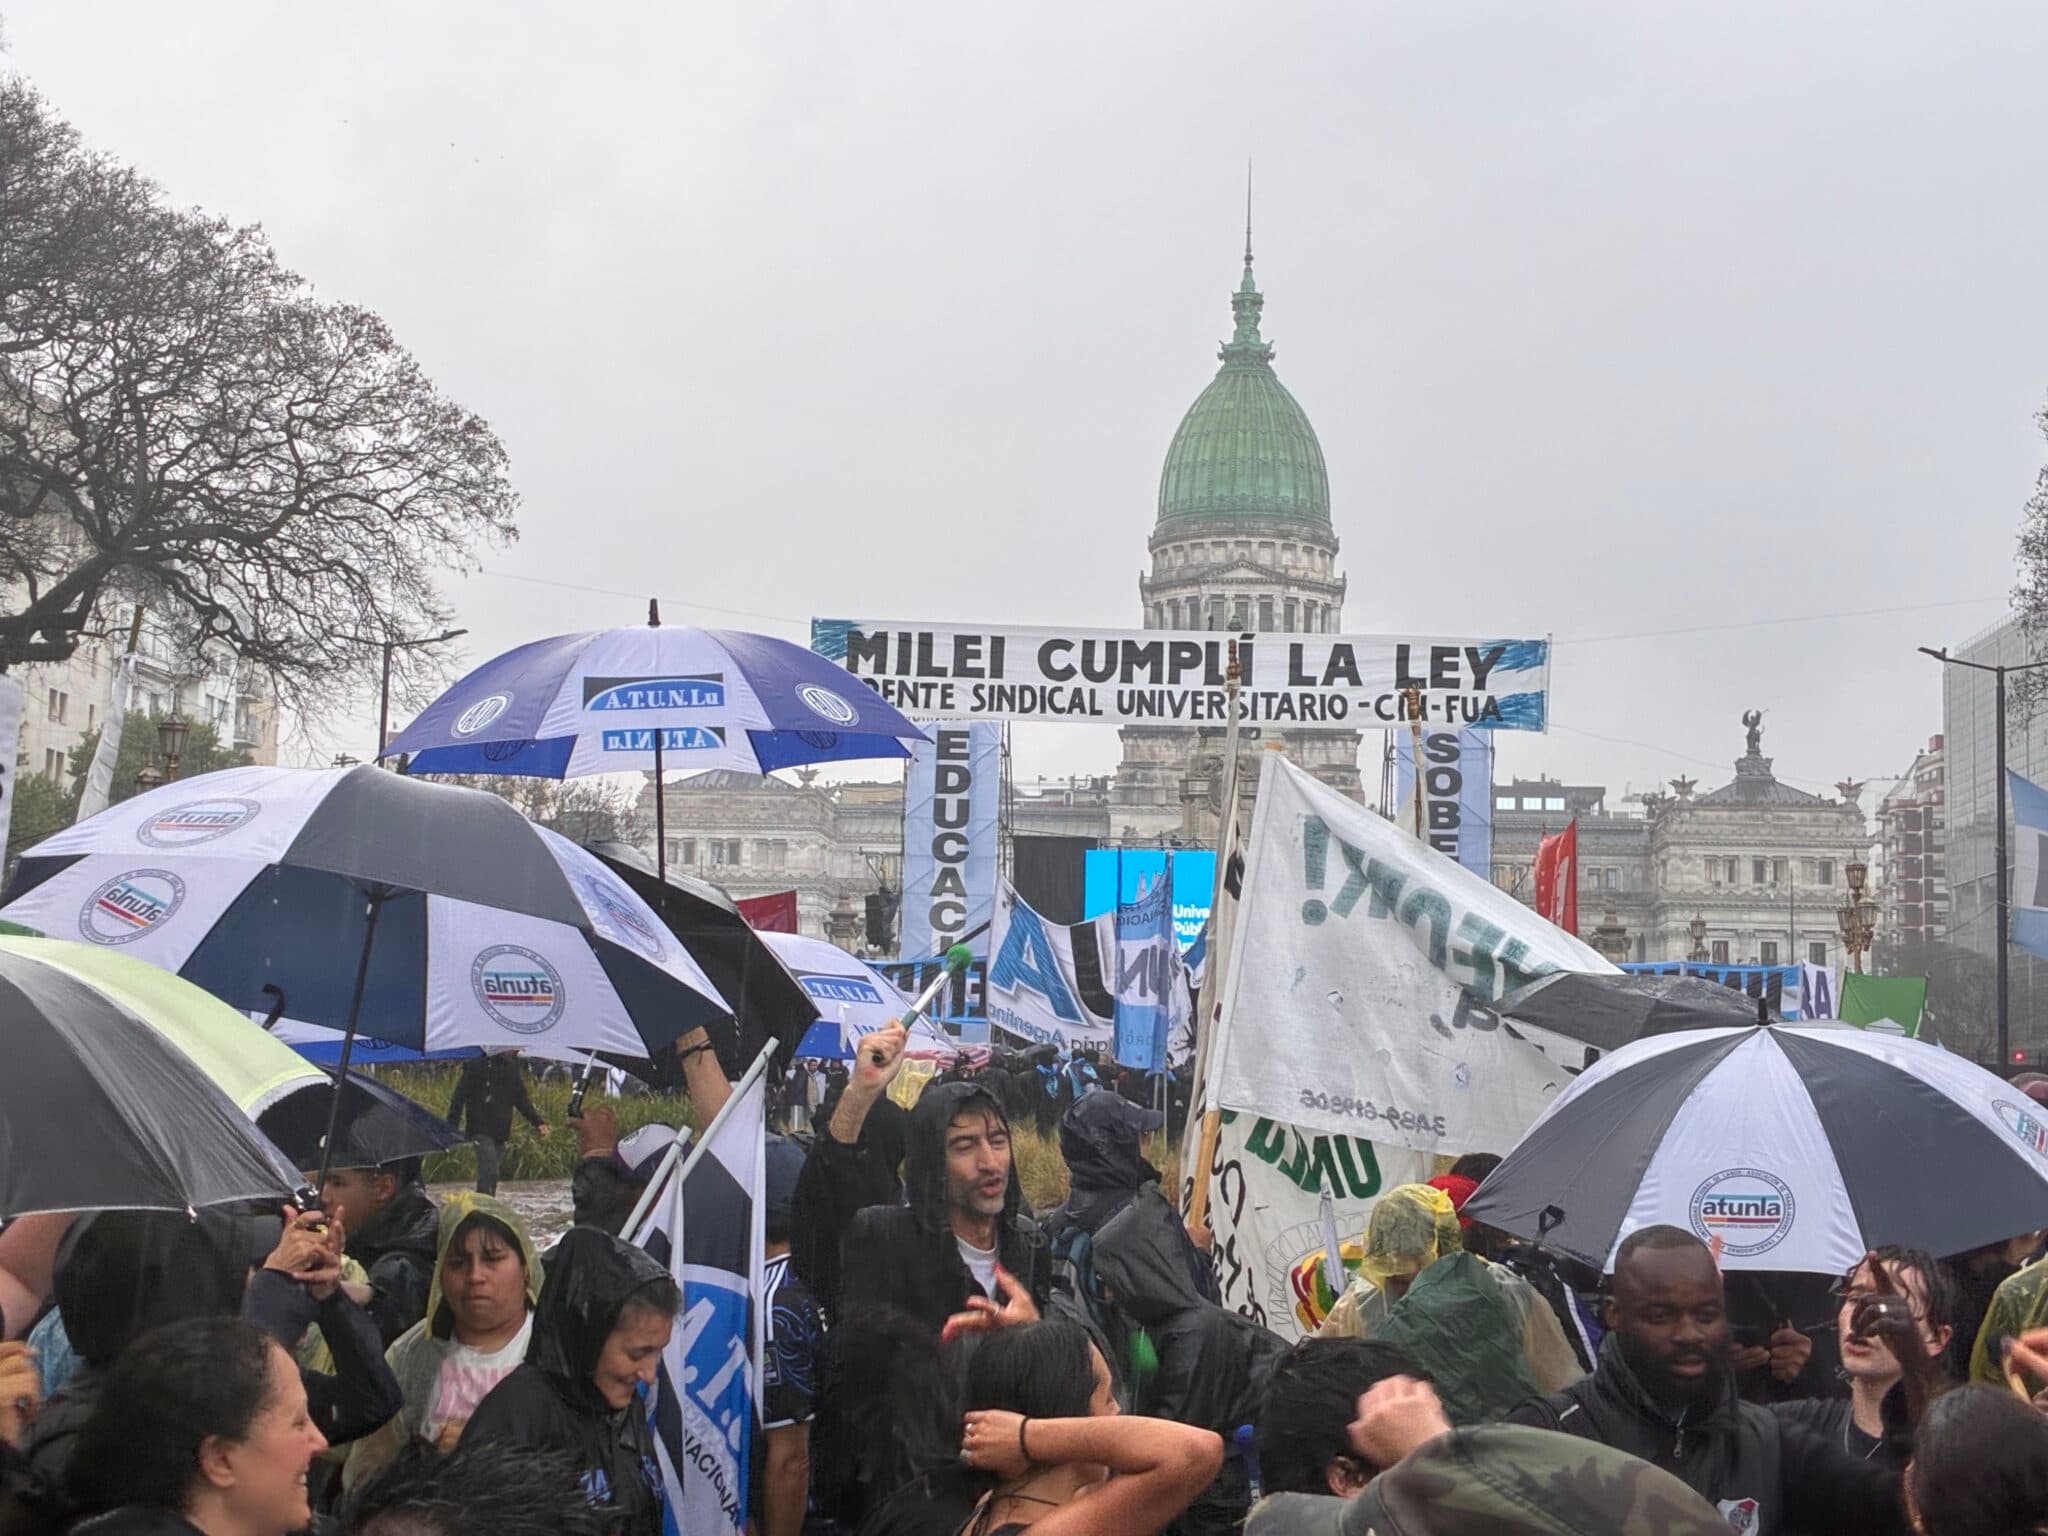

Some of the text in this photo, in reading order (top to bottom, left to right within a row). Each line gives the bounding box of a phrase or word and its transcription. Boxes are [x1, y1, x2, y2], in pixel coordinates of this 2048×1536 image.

[847, 630, 1507, 691] MILEI CUMPLÍ LA LEY
[970, 683, 1103, 716] SINDICAL
[1116, 689, 1348, 722] UNIVERSITARIO
[1425, 732, 1463, 862] SOBE
[1702, 1197, 1781, 1217] atunla
